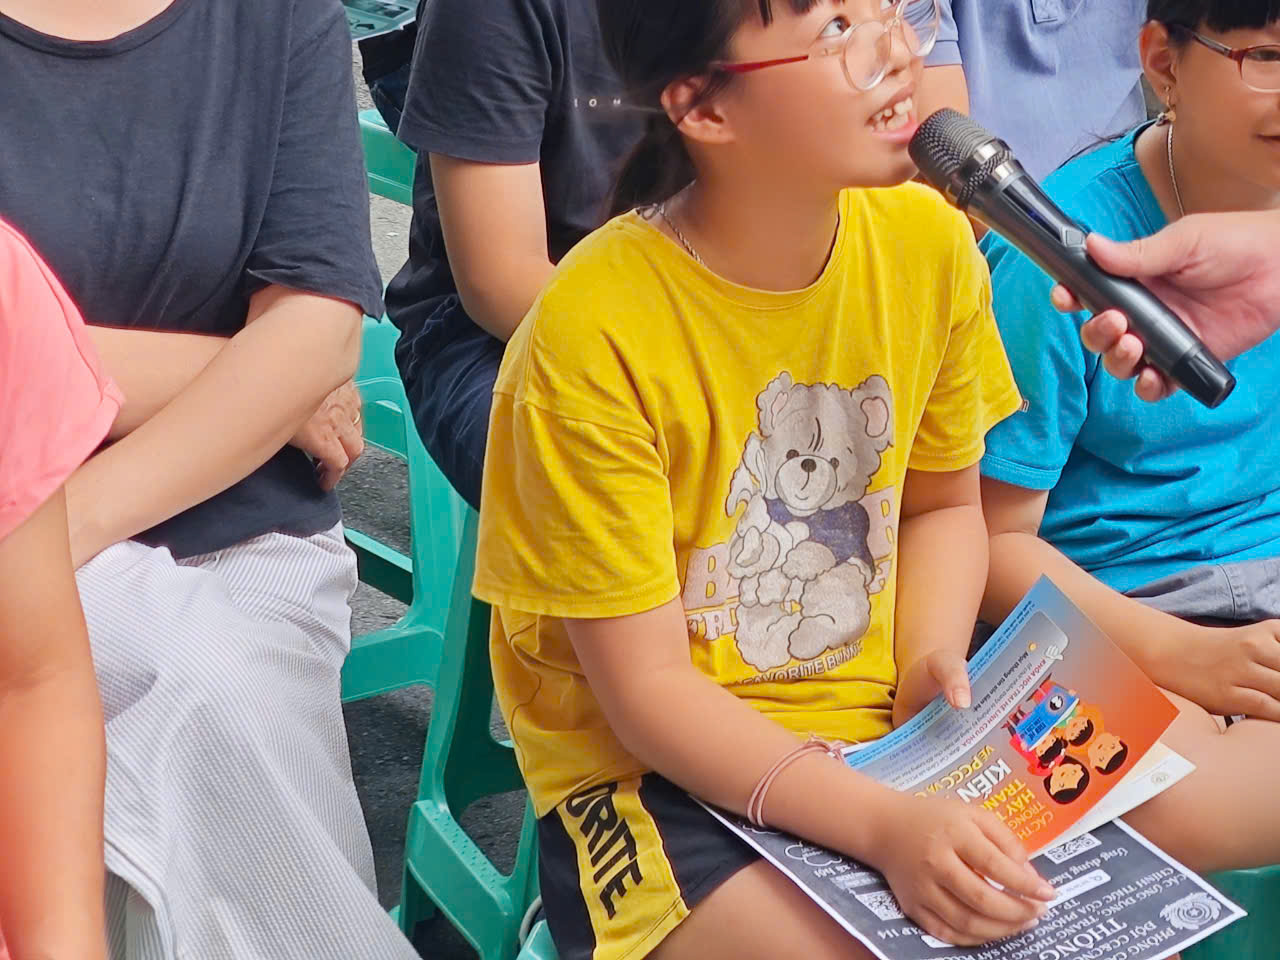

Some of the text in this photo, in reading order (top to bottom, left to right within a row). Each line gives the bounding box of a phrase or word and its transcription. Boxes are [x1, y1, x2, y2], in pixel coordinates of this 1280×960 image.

[1002, 660, 1020, 679] thông
[996, 677, 1005, 687] tin
[939, 754, 982, 790] PCCC
[955, 756, 1011, 804] KIẾN
[1006, 799, 1045, 831] TRONG
[566, 782, 643, 920] ORITE
[1101, 845, 1129, 862] Ứng
[813, 863, 836, 882] hội
[1070, 857, 1102, 876] dụng
[1135, 866, 1174, 888] CHÍNH
[1102, 883, 1136, 904] THỨC
[1132, 882, 1163, 902] ỨNG
[1057, 897, 1080, 912] TP.
[1076, 898, 1103, 914] CỦA
[876, 928, 900, 940] 114
[1033, 910, 1078, 938] PHÒNG
[1054, 913, 1099, 940] TRANG
[1129, 919, 1156, 938] ĐỘI
[999, 931, 1035, 954] CẢNH
[1010, 933, 1056, 960] THÔNG
[1038, 916, 1127, 959] THÔNG
[1126, 926, 1176, 956] PHÒNG
